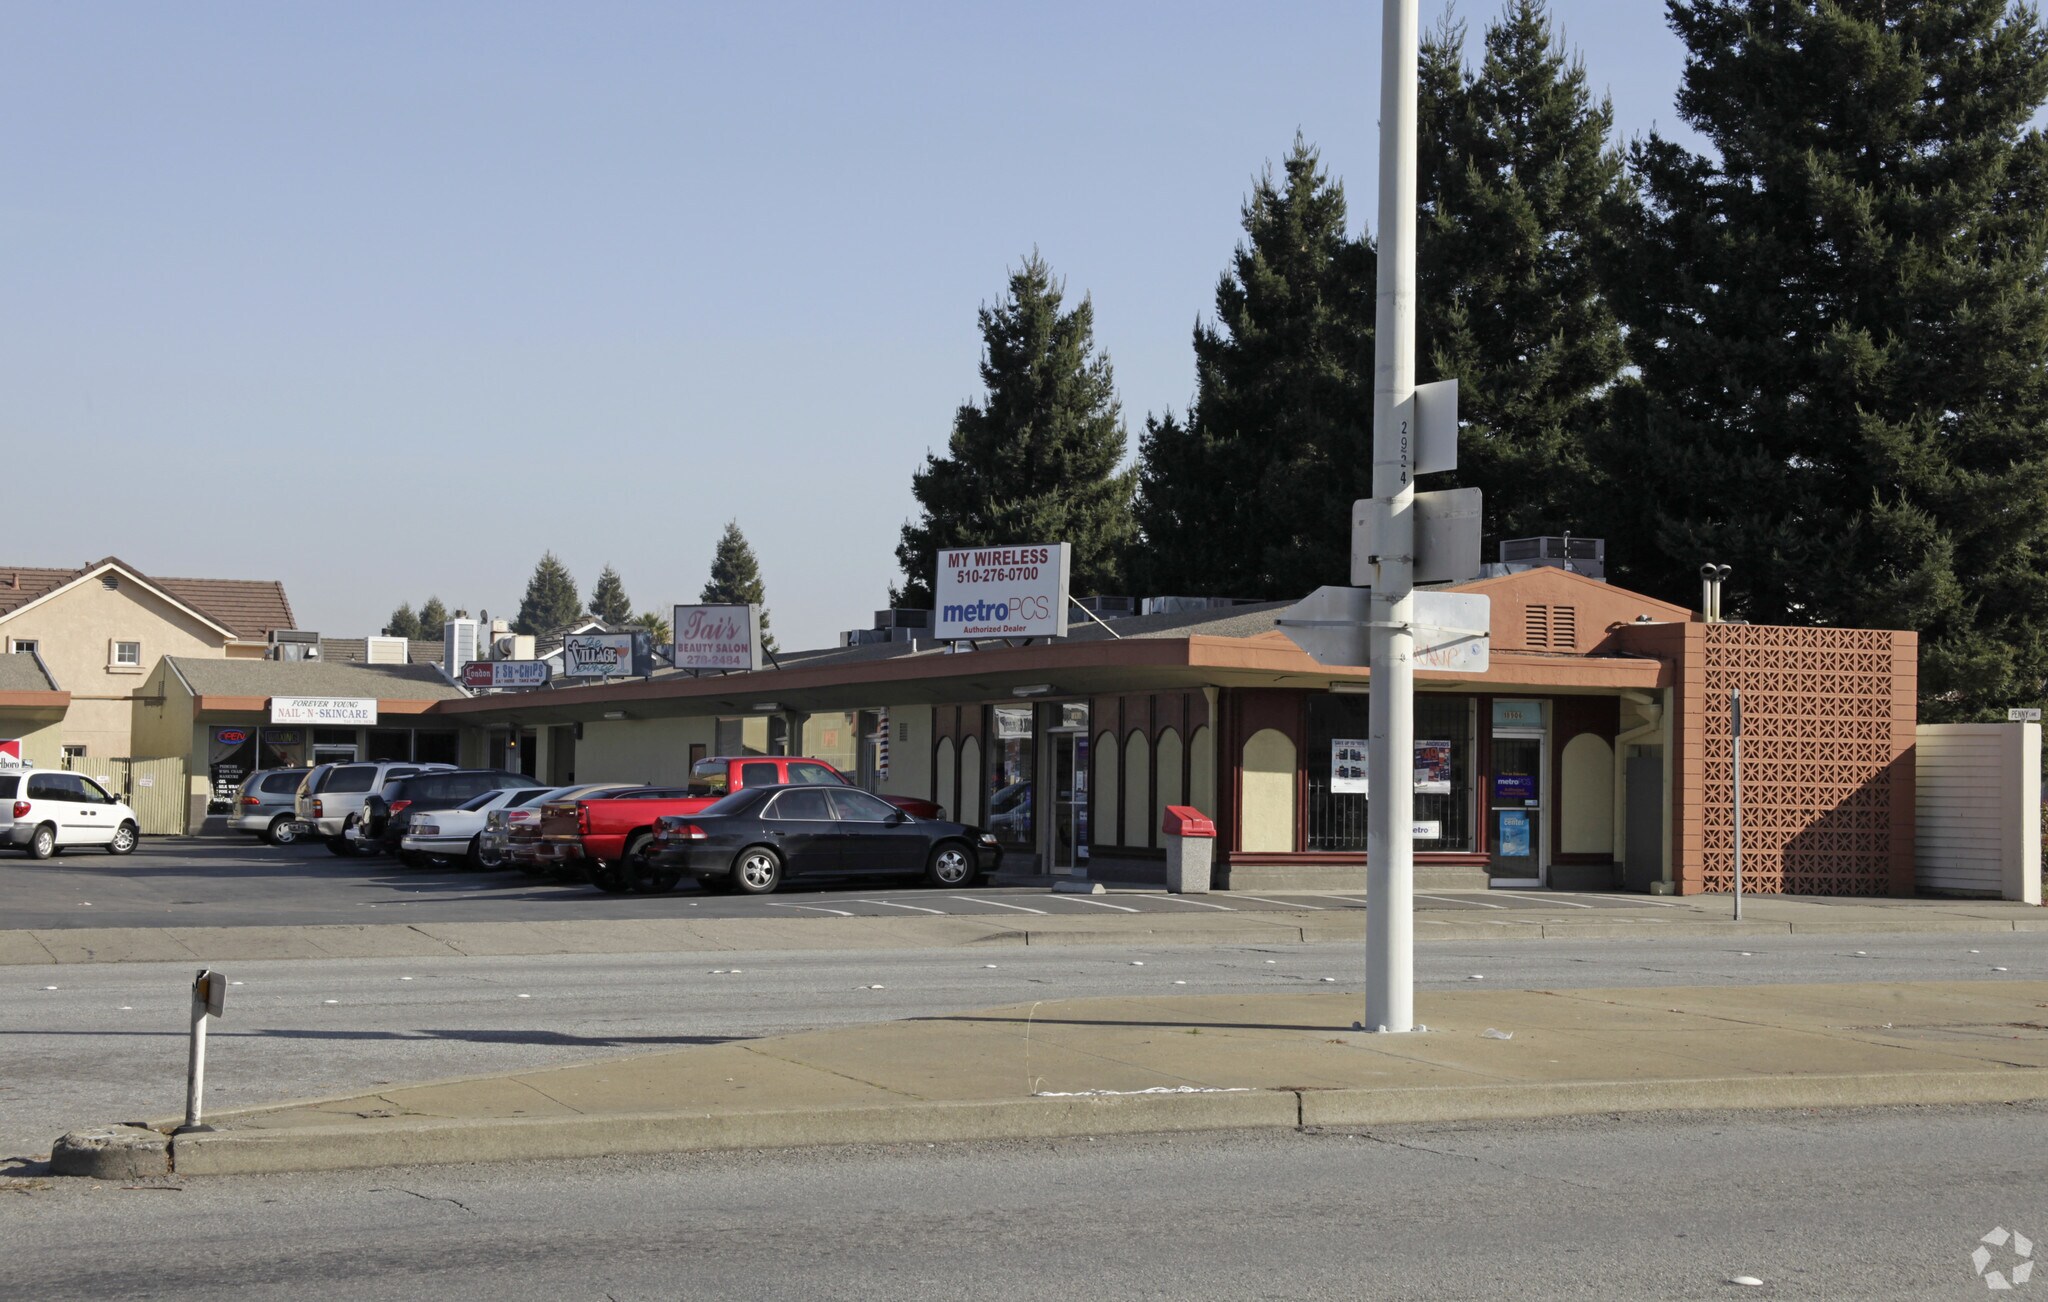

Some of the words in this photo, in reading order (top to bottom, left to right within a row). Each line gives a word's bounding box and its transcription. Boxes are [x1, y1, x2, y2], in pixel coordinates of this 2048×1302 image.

[948, 553, 970, 568] MY
[974, 548, 1048, 566] WIRELESS
[957, 567, 1039, 583] 510-276-0700
[943, 595, 1051, 622] metroPCS
[684, 609, 741, 640] Tai's
[963, 626, 1001, 634] Authorized
[678, 643, 714, 653] BEAUTY
[716, 643, 749, 653] SALON
[568, 640, 617, 670] VILLAGE
[465, 666, 491, 680] London
[495, 665, 513, 678] FSH
[519, 663, 544, 678] CHIPS
[292, 700, 329, 708] FOREVER
[278, 708, 301, 718] NAIL
[2011, 710, 2029, 719] PENNY
[0, 758, 19, 768] lboro
[1504, 818, 1525, 826] center
